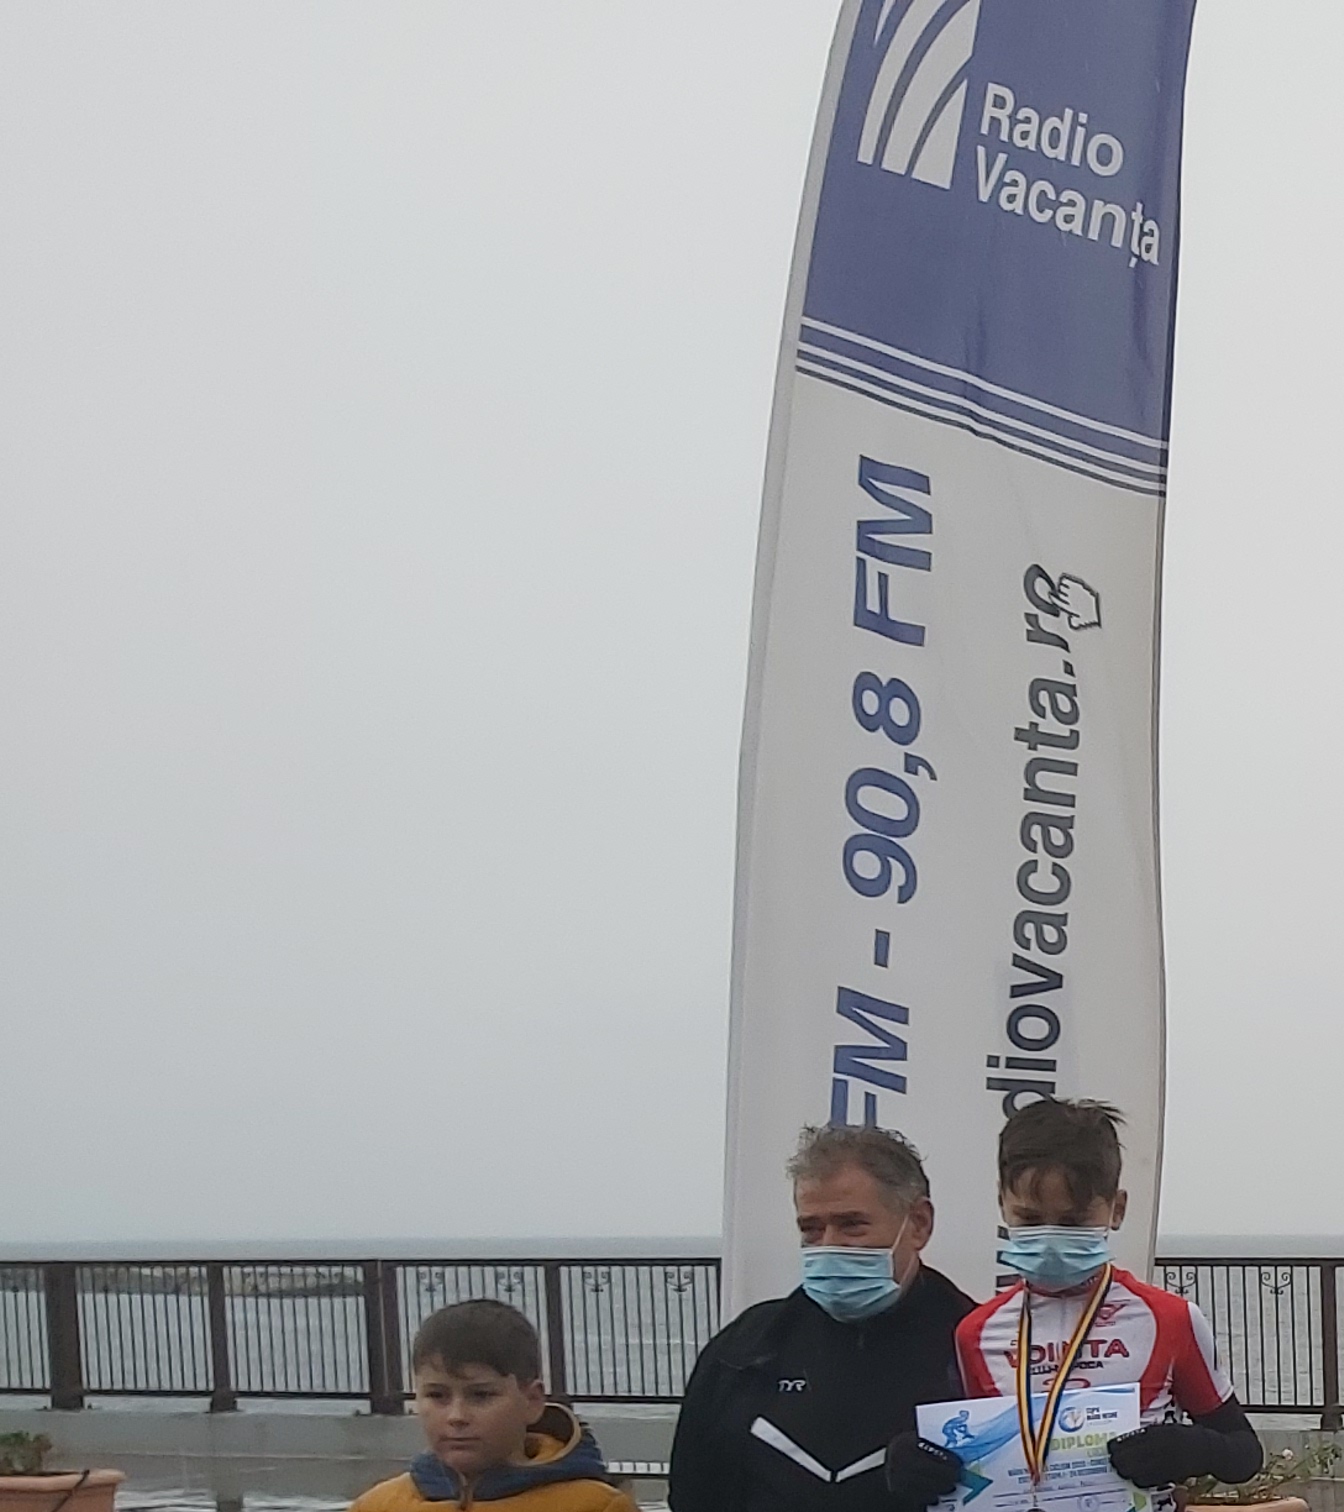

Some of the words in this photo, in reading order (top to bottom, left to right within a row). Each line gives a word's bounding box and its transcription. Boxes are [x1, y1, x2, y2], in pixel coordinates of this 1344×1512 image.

[974, 145, 1160, 268] Vacanța
[978, 82, 1124, 177] Radio
[853, 454, 933, 647] FM
[843, 671, 938, 904] 90,8
